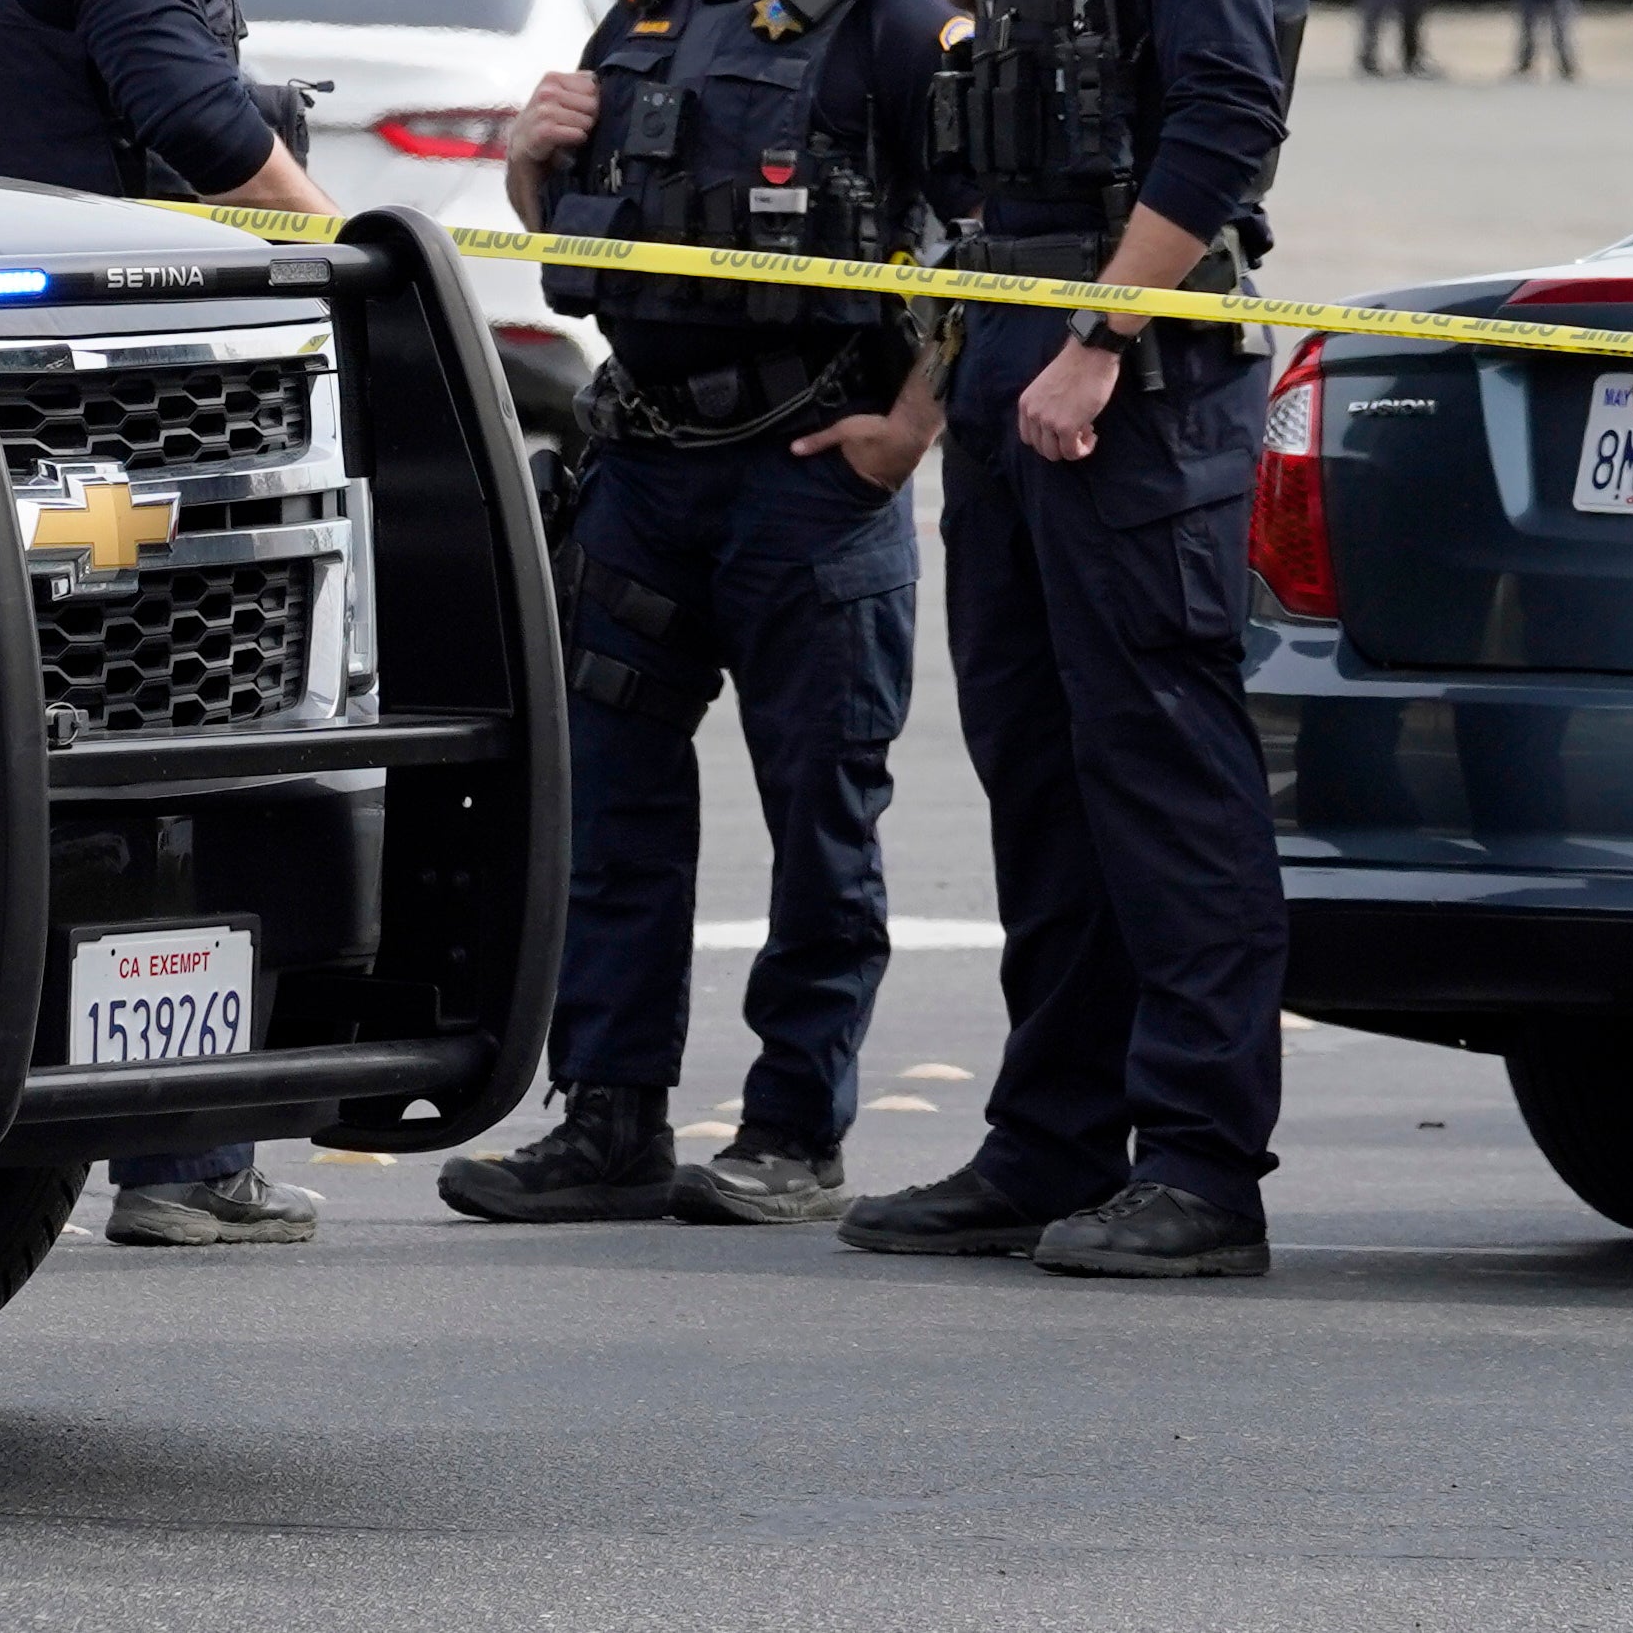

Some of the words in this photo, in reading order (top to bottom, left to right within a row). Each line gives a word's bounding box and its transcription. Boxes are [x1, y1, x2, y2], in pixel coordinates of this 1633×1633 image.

[107, 265, 205, 289] SETINA
[1603, 387, 1630, 407] MAY
[118, 958, 140, 979] CA
[149, 951, 211, 977] EXEMPT
[88, 989, 241, 1064] 1539269
